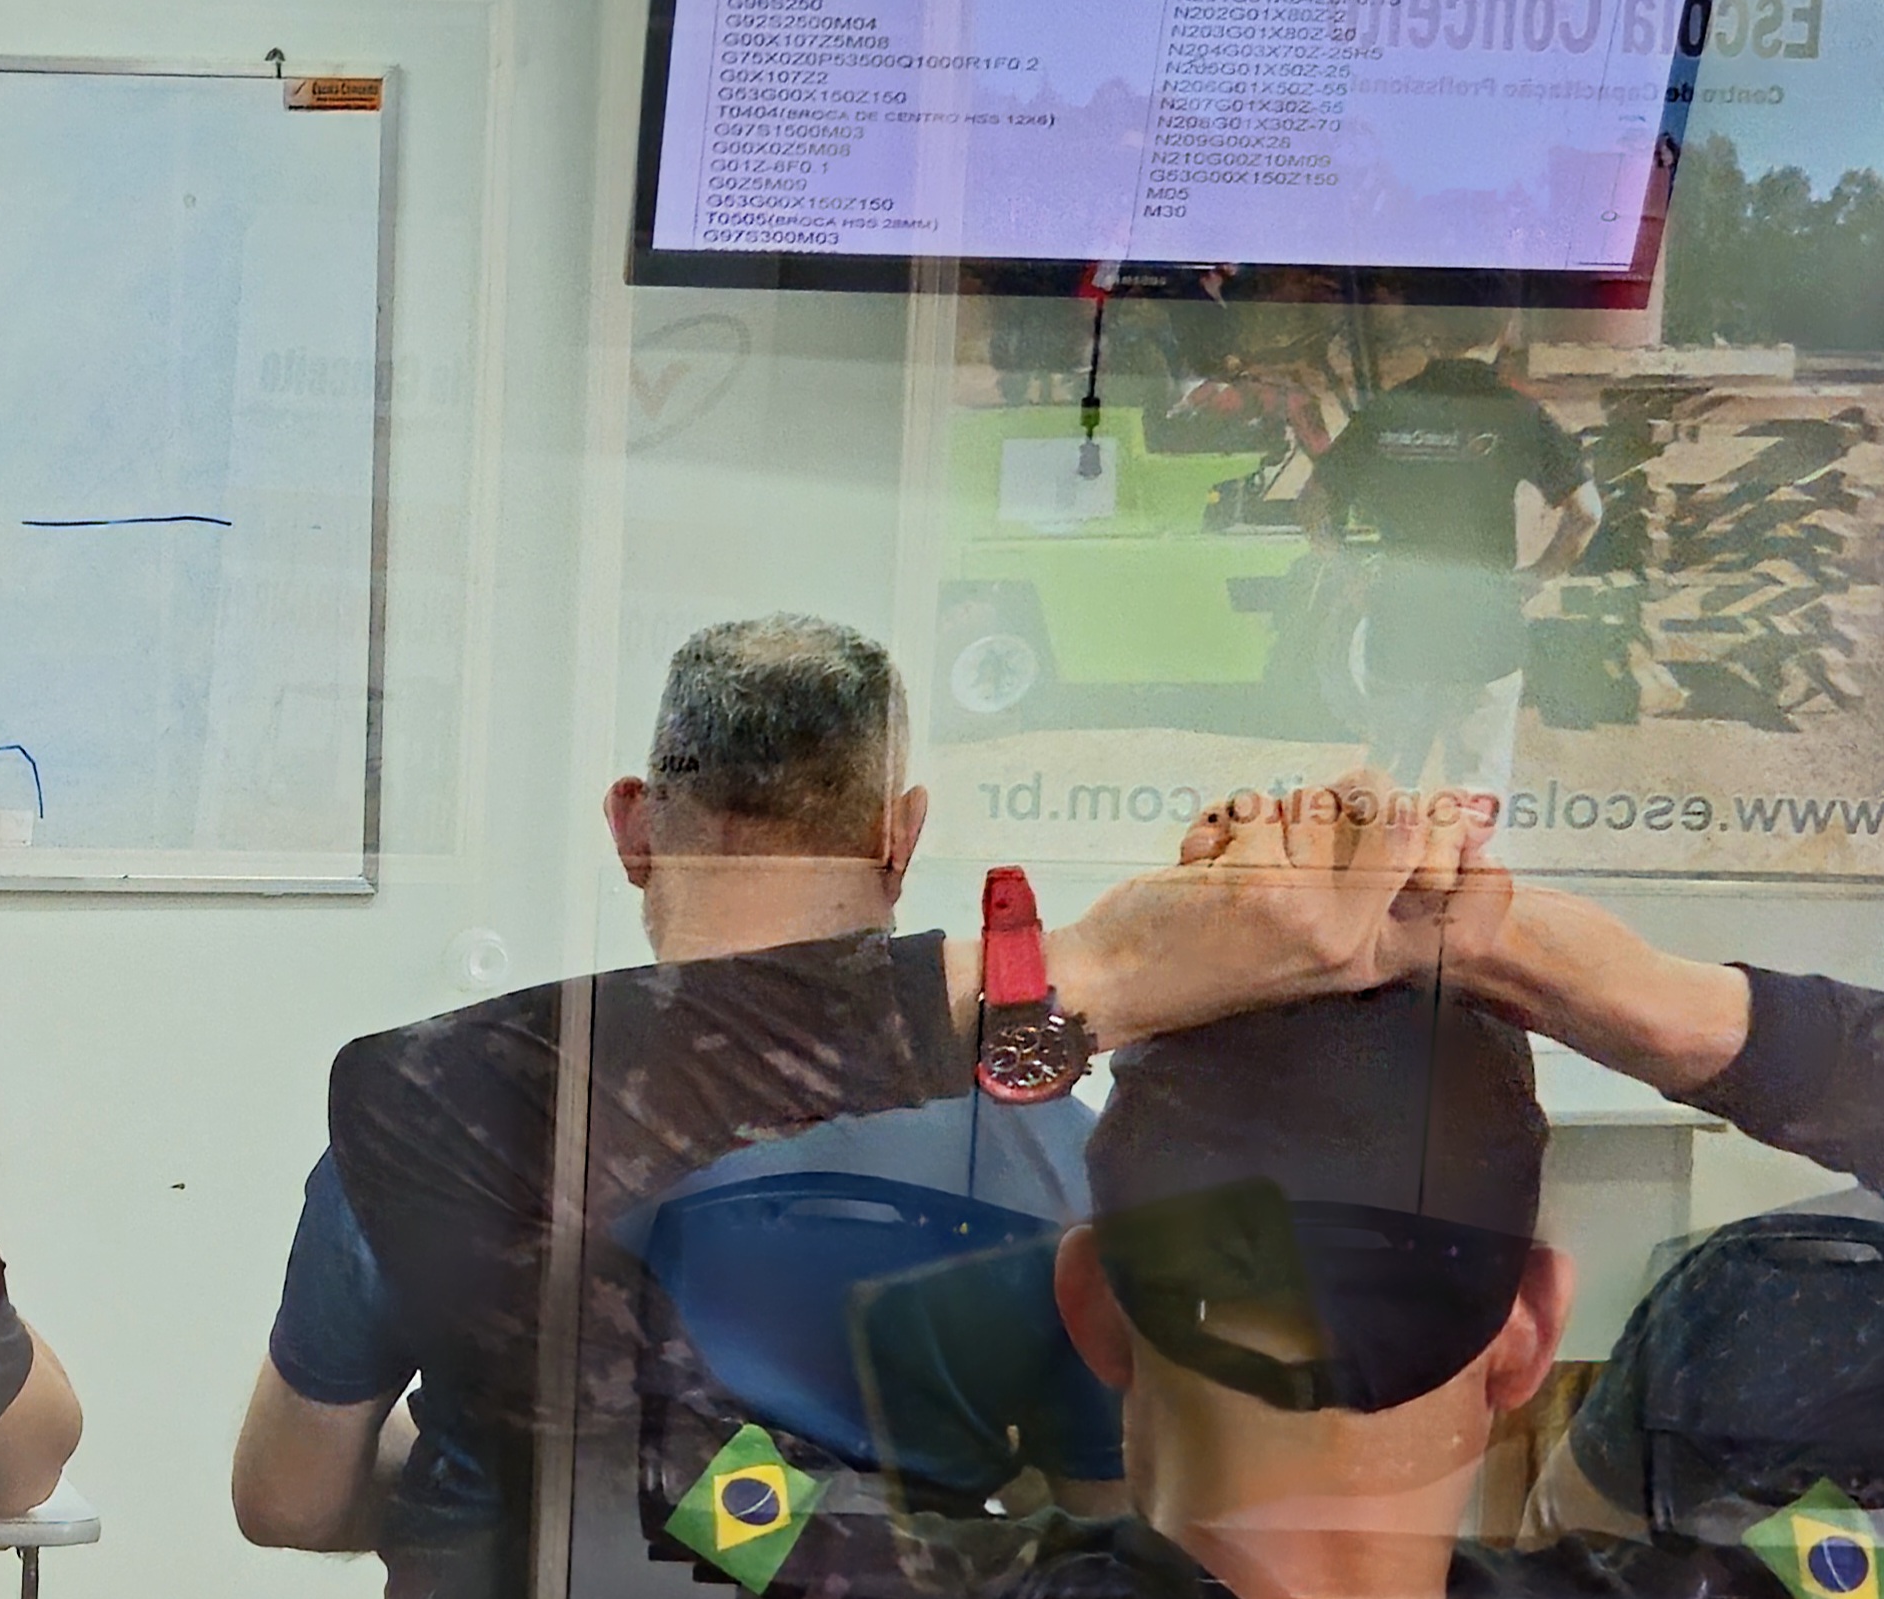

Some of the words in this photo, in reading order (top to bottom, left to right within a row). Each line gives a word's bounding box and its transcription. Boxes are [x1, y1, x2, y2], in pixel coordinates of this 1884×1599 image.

[721, 33, 891, 49] G00X107Z5M08
[854, 111, 880, 122] DE
[884, 112, 959, 124] CENTRO
[965, 113, 1001, 125] HSS
[713, 123, 865, 140] G97S1500M03
[1146, 187, 1189, 200] M05
[1143, 205, 1186, 218] M30
